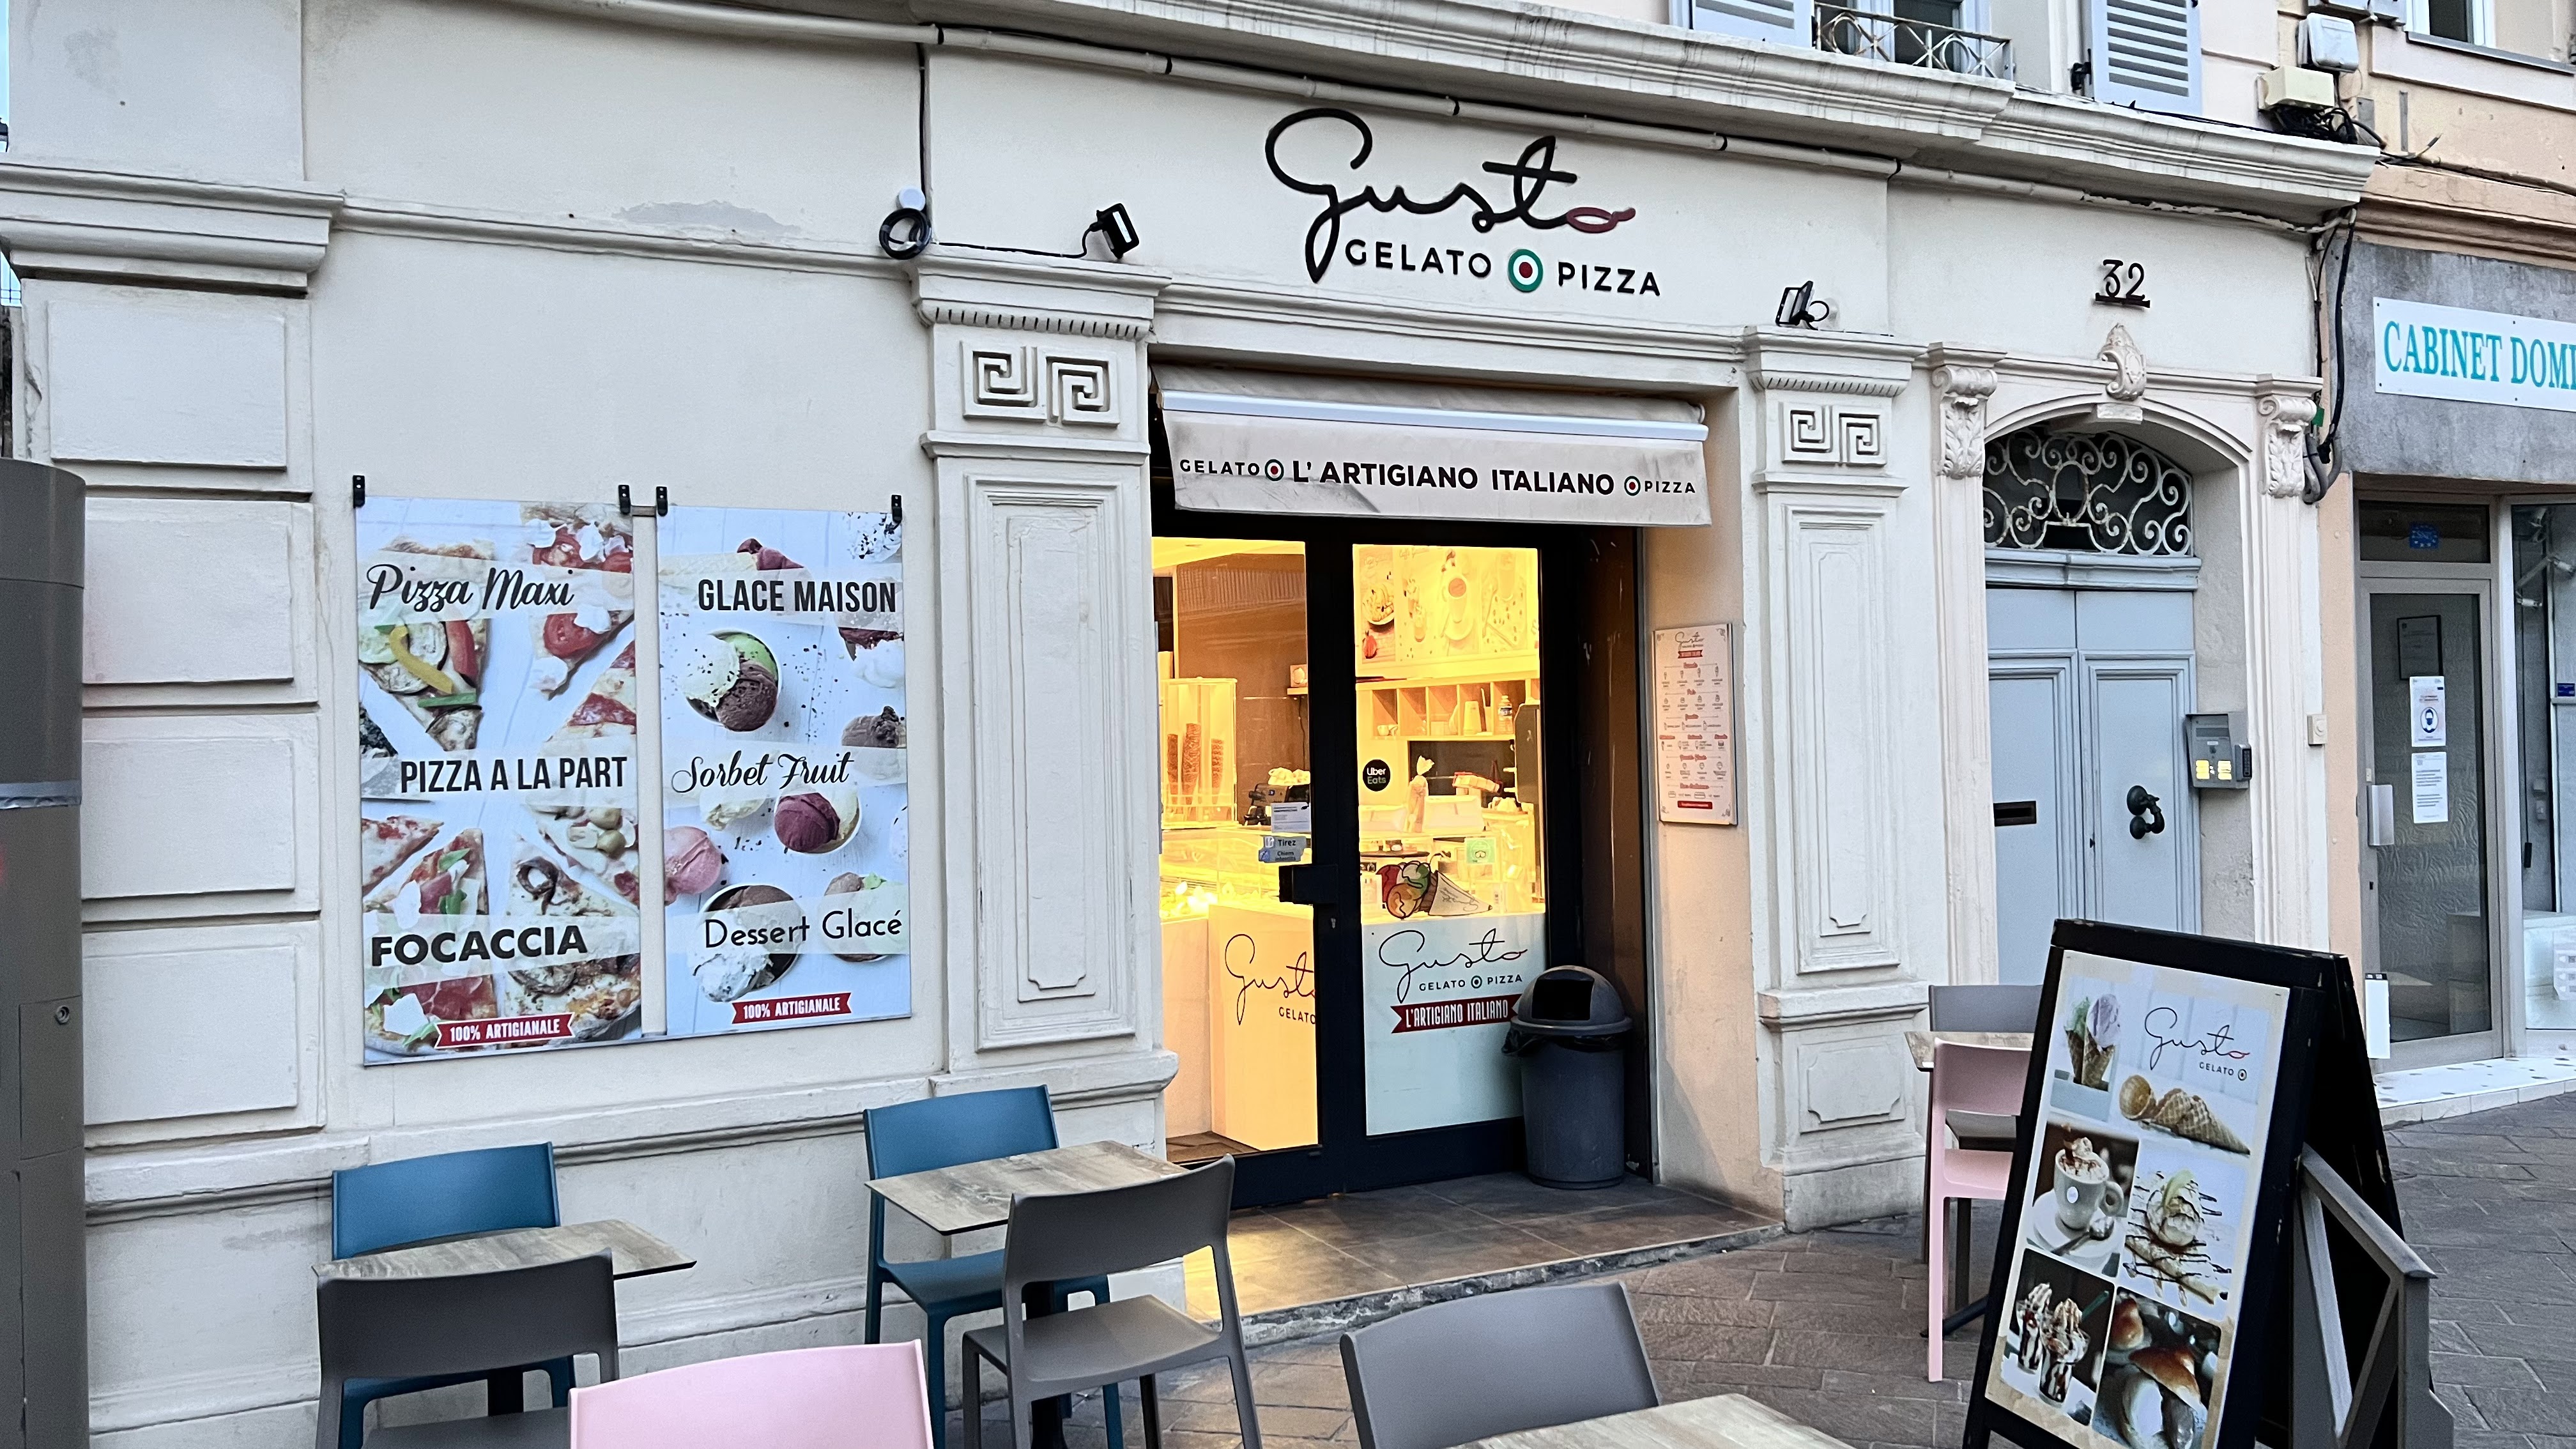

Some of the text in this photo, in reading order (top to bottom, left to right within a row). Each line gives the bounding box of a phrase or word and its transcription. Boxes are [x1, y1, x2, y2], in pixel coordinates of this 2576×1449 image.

[1345, 238, 1660, 296] GELATO PIZZA
[2102, 259, 2145, 301] 32
[2384, 320, 2503, 382] CABINET
[1179, 459, 1260, 475] GELATO
[1492, 469, 1614, 495] ITALIANO
[1644, 480, 1696, 494] PIZZA
[366, 564, 574, 613] Pizza Maxi
[698, 579, 896, 613] GLACE MAISON
[401, 756, 627, 793] PIZZA A LA PART
[671, 750, 855, 793] Sorbet Fruit
[1367, 767, 1386, 776] Uber
[1367, 776, 1386, 785] Eats
[371, 924, 588, 967] FOCACCIA
[705, 907, 902, 948] Dessert Glacé
[1225, 933, 1315, 1026] Gust
[1418, 974, 1523, 992] GELATO PIZZA
[743, 997, 841, 1020] 100% ARTIGIANALE
[1405, 999, 1508, 1028] L'ARTIGIANO ITALIANO
[449, 1018, 560, 1042] 100% ARTIGIANALE
[2199, 1061, 2234, 1076] GELATO
